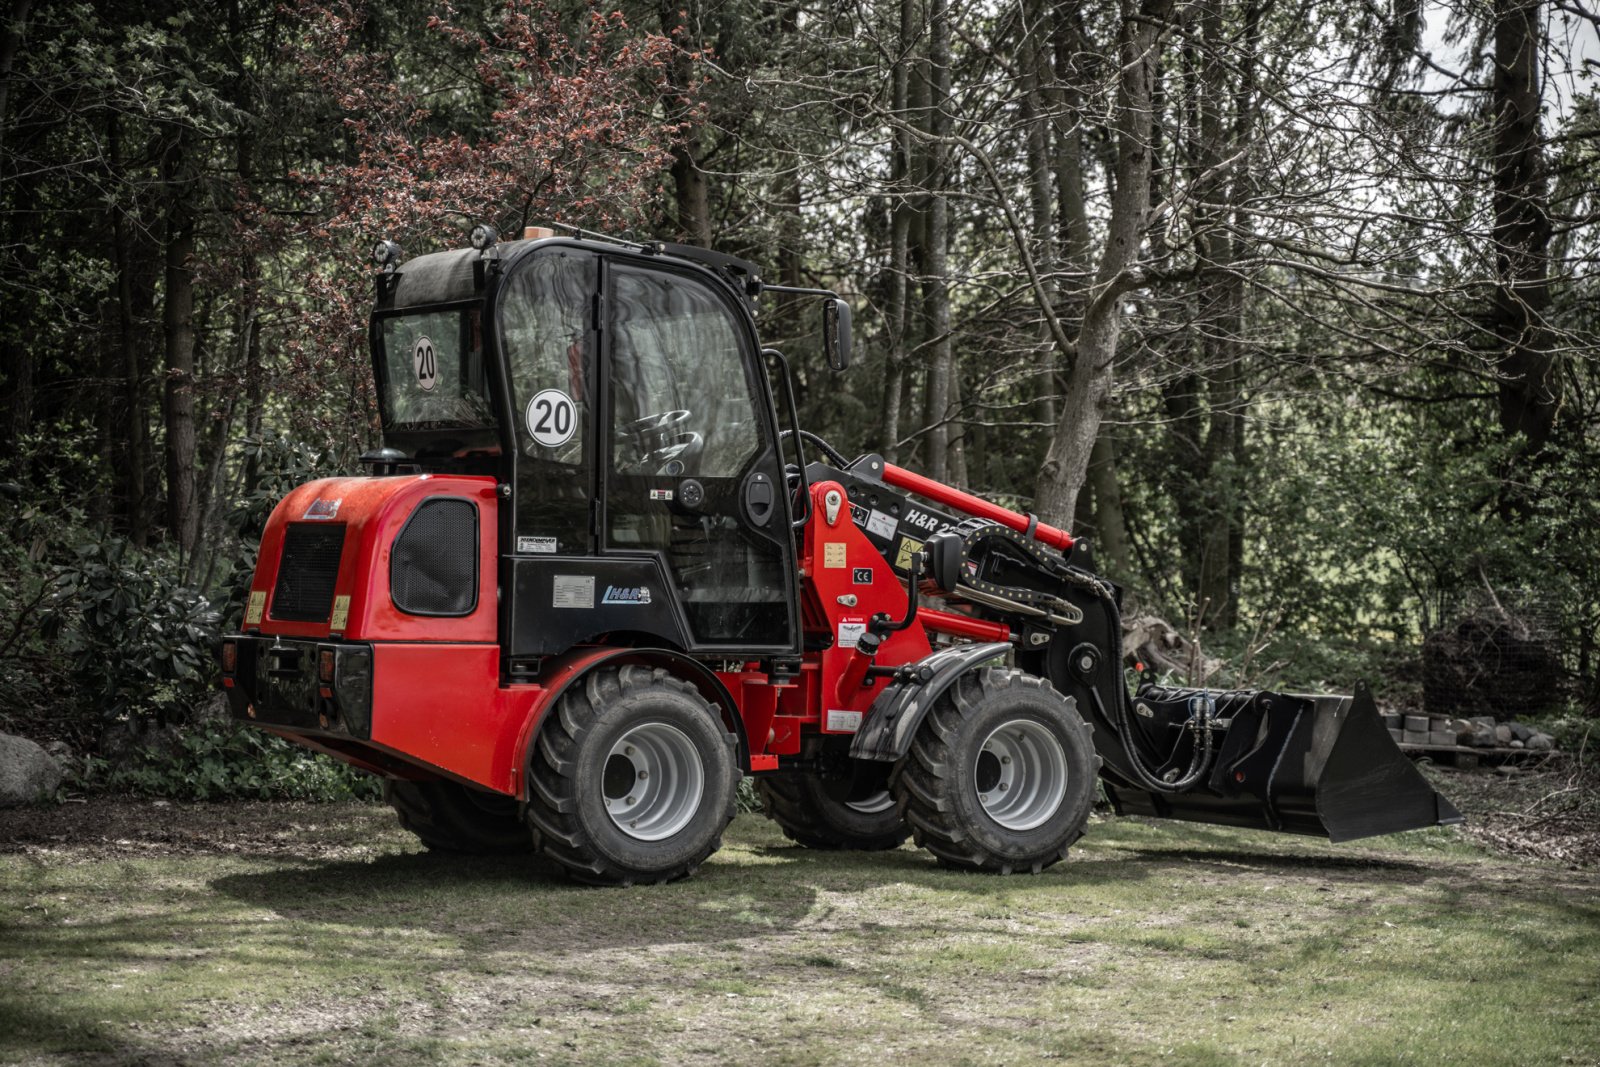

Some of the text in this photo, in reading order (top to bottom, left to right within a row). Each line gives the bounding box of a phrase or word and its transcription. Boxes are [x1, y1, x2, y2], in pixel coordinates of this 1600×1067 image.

[416, 345, 435, 380] 20
[534, 399, 571, 435] 20
[904, 509, 939, 532] H&R
[857, 571, 869, 582] CE
